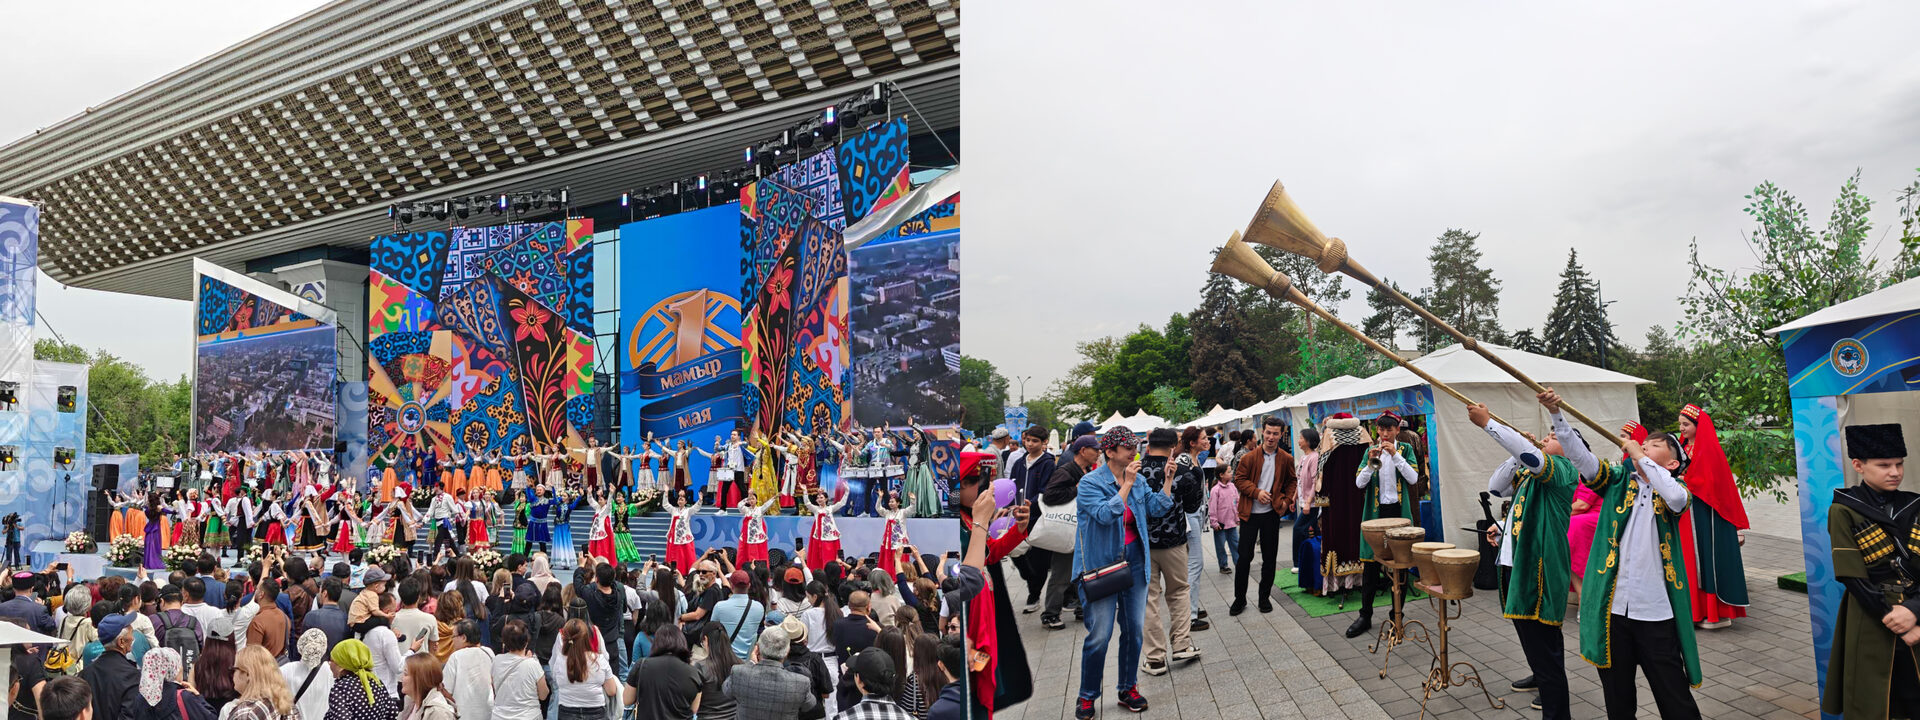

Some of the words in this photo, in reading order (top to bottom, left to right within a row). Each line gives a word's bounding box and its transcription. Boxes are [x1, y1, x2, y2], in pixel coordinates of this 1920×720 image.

[668, 288, 709, 366] 1
[660, 358, 723, 391] мамыр
[678, 407, 712, 430] мая
